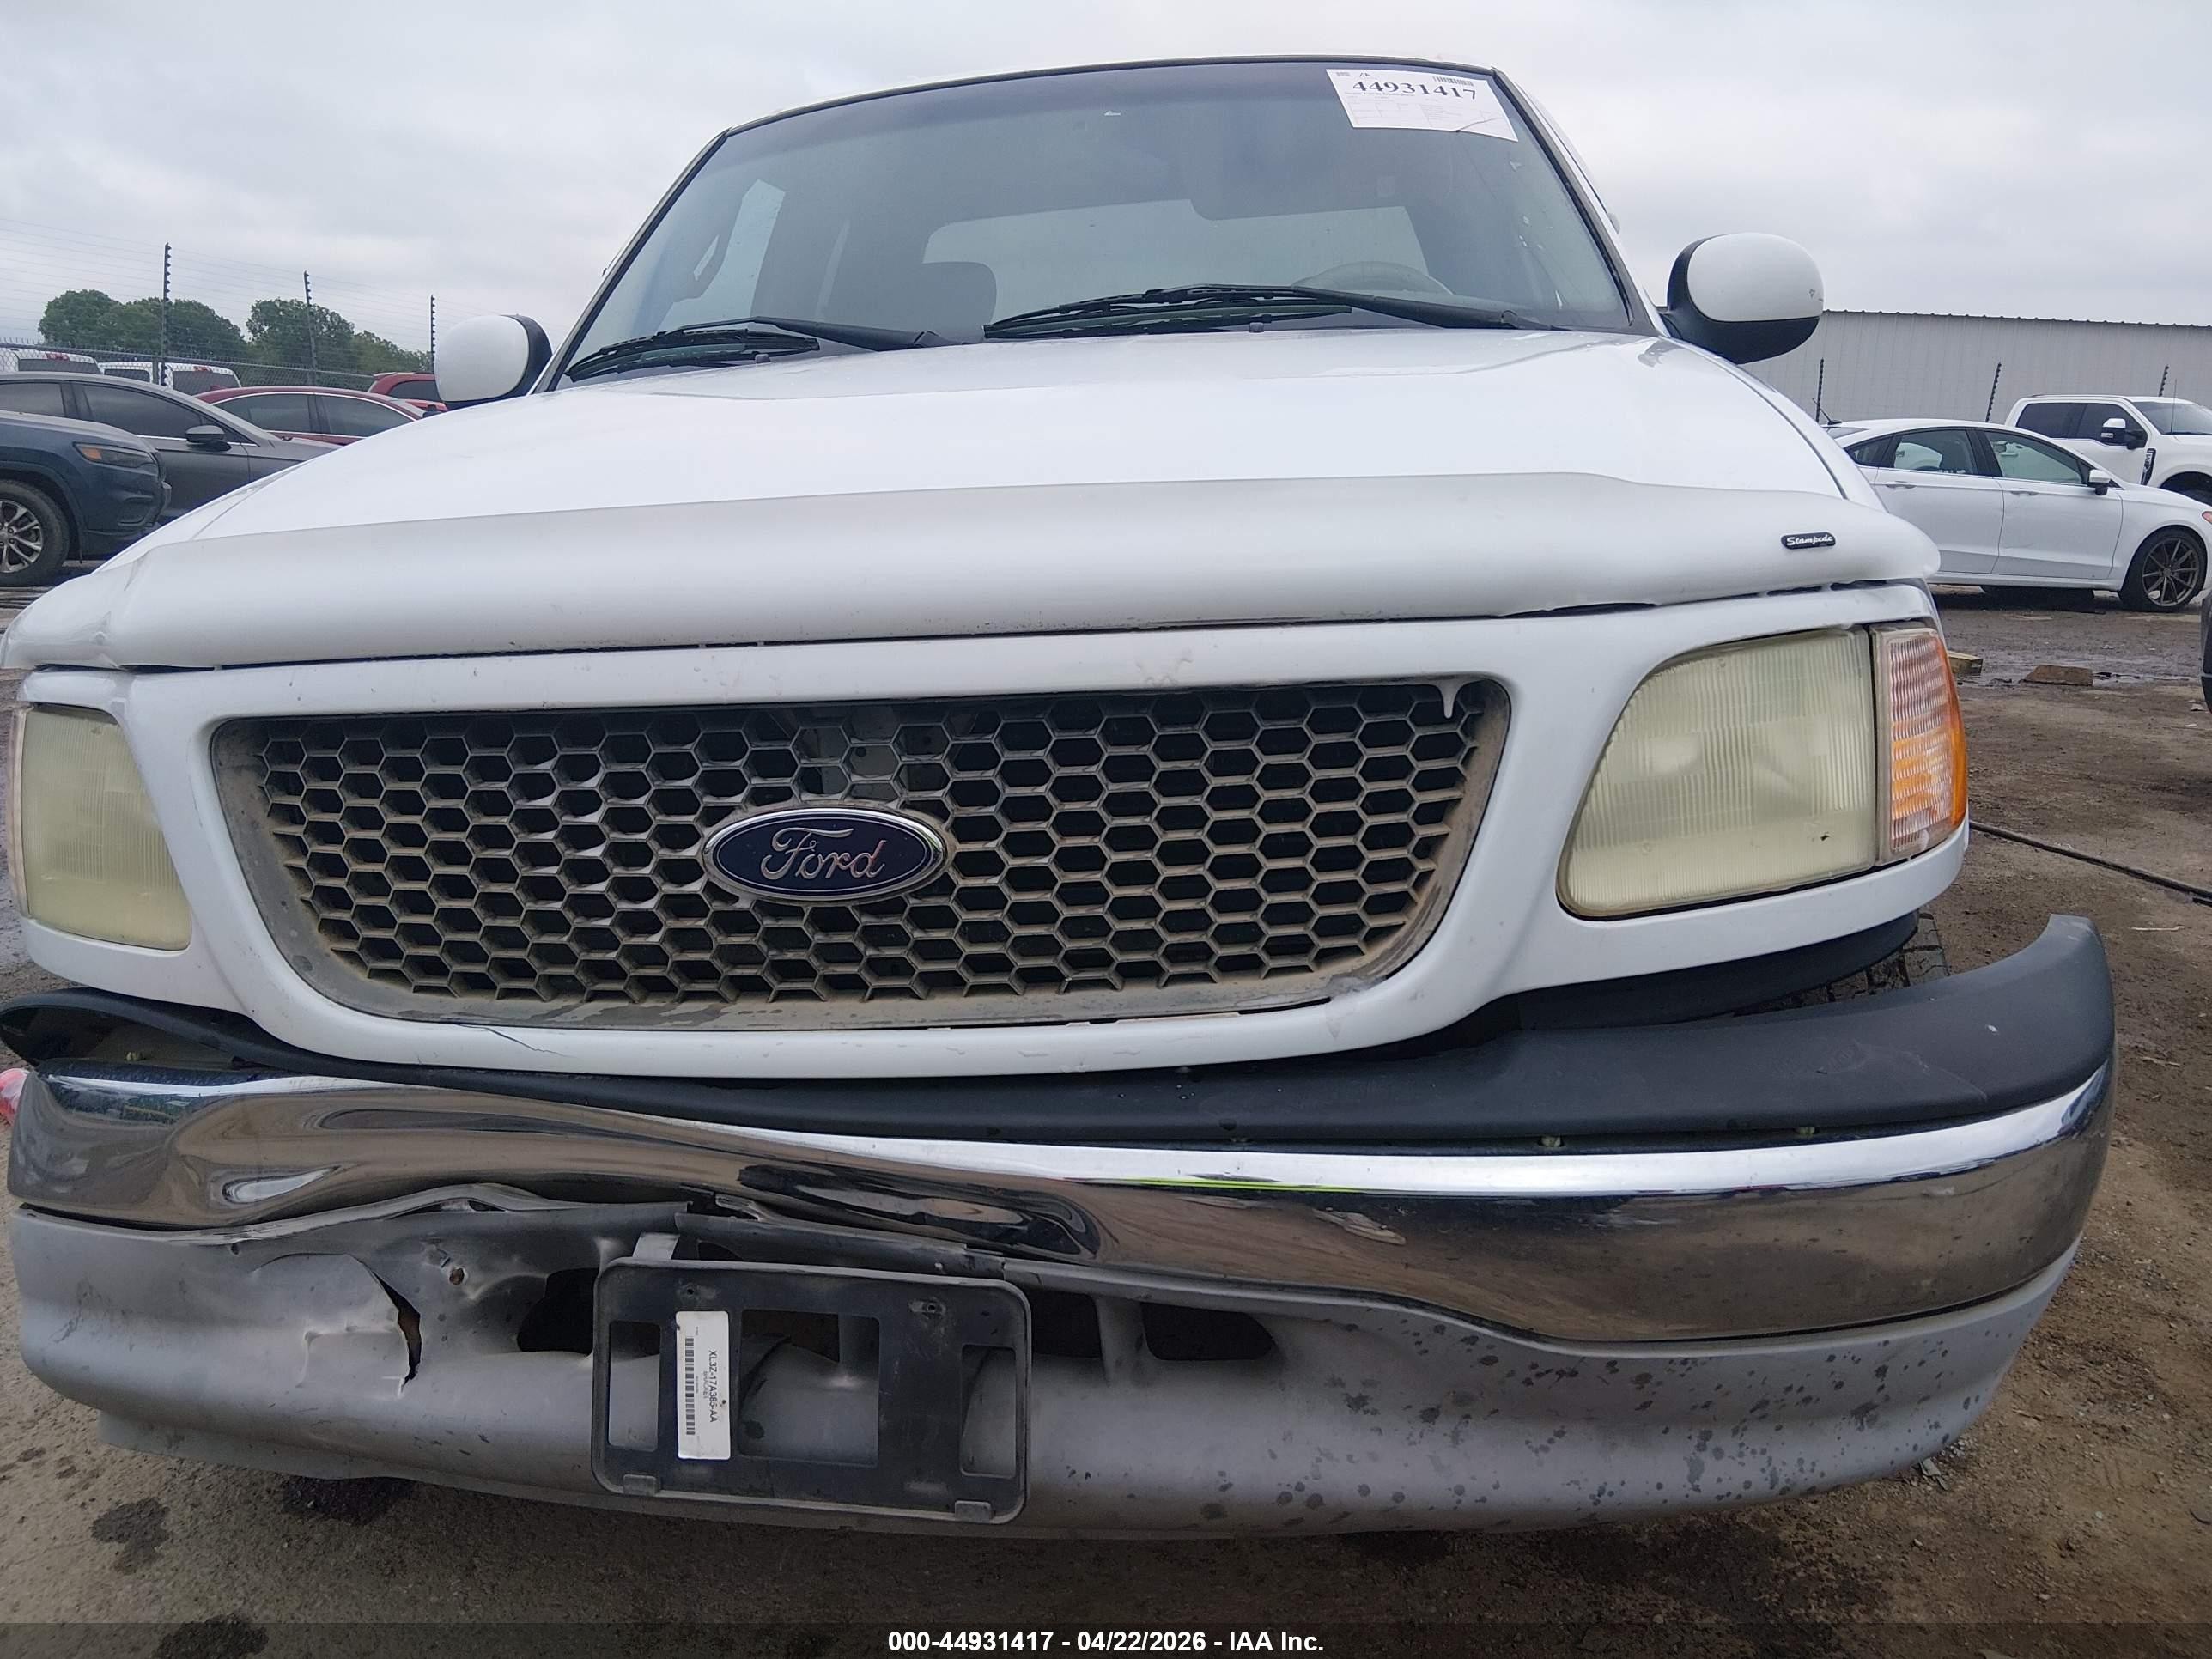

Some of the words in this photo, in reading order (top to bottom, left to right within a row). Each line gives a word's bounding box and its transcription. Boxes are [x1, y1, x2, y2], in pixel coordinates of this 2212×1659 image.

[1352, 81, 1476, 100] 44931417
[1786, 534, 1833, 545] Stampede
[760, 827, 887, 880] Ford
[708, 1350, 718, 1423] XL3Z-17A385-AA
